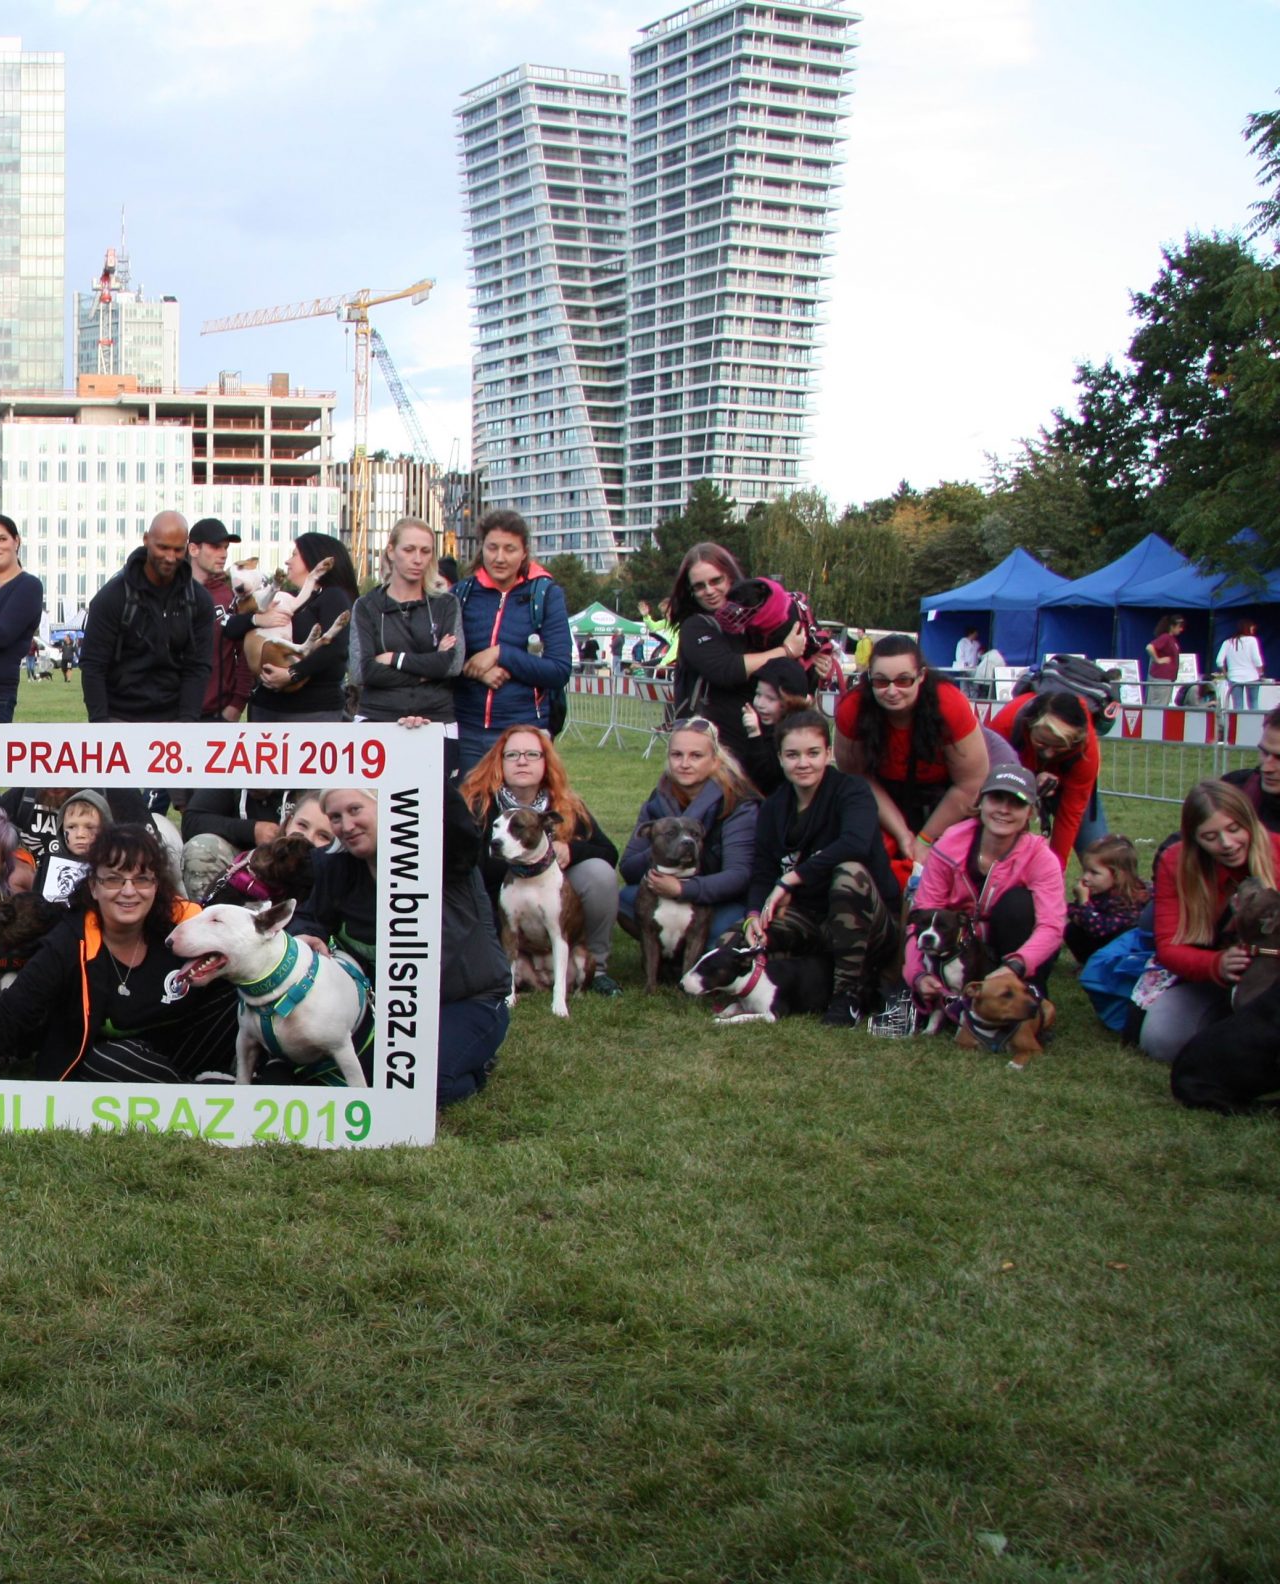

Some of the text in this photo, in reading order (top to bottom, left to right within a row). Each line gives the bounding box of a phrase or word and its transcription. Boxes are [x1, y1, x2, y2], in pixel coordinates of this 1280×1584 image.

[7, 732, 386, 779] PRAHA 28. ZÁŘÍ 2019
[386, 788, 429, 1089] www.bullsraz.cz
[91, 1095, 235, 1139] SRAZ
[252, 1099, 372, 1142] 2019
